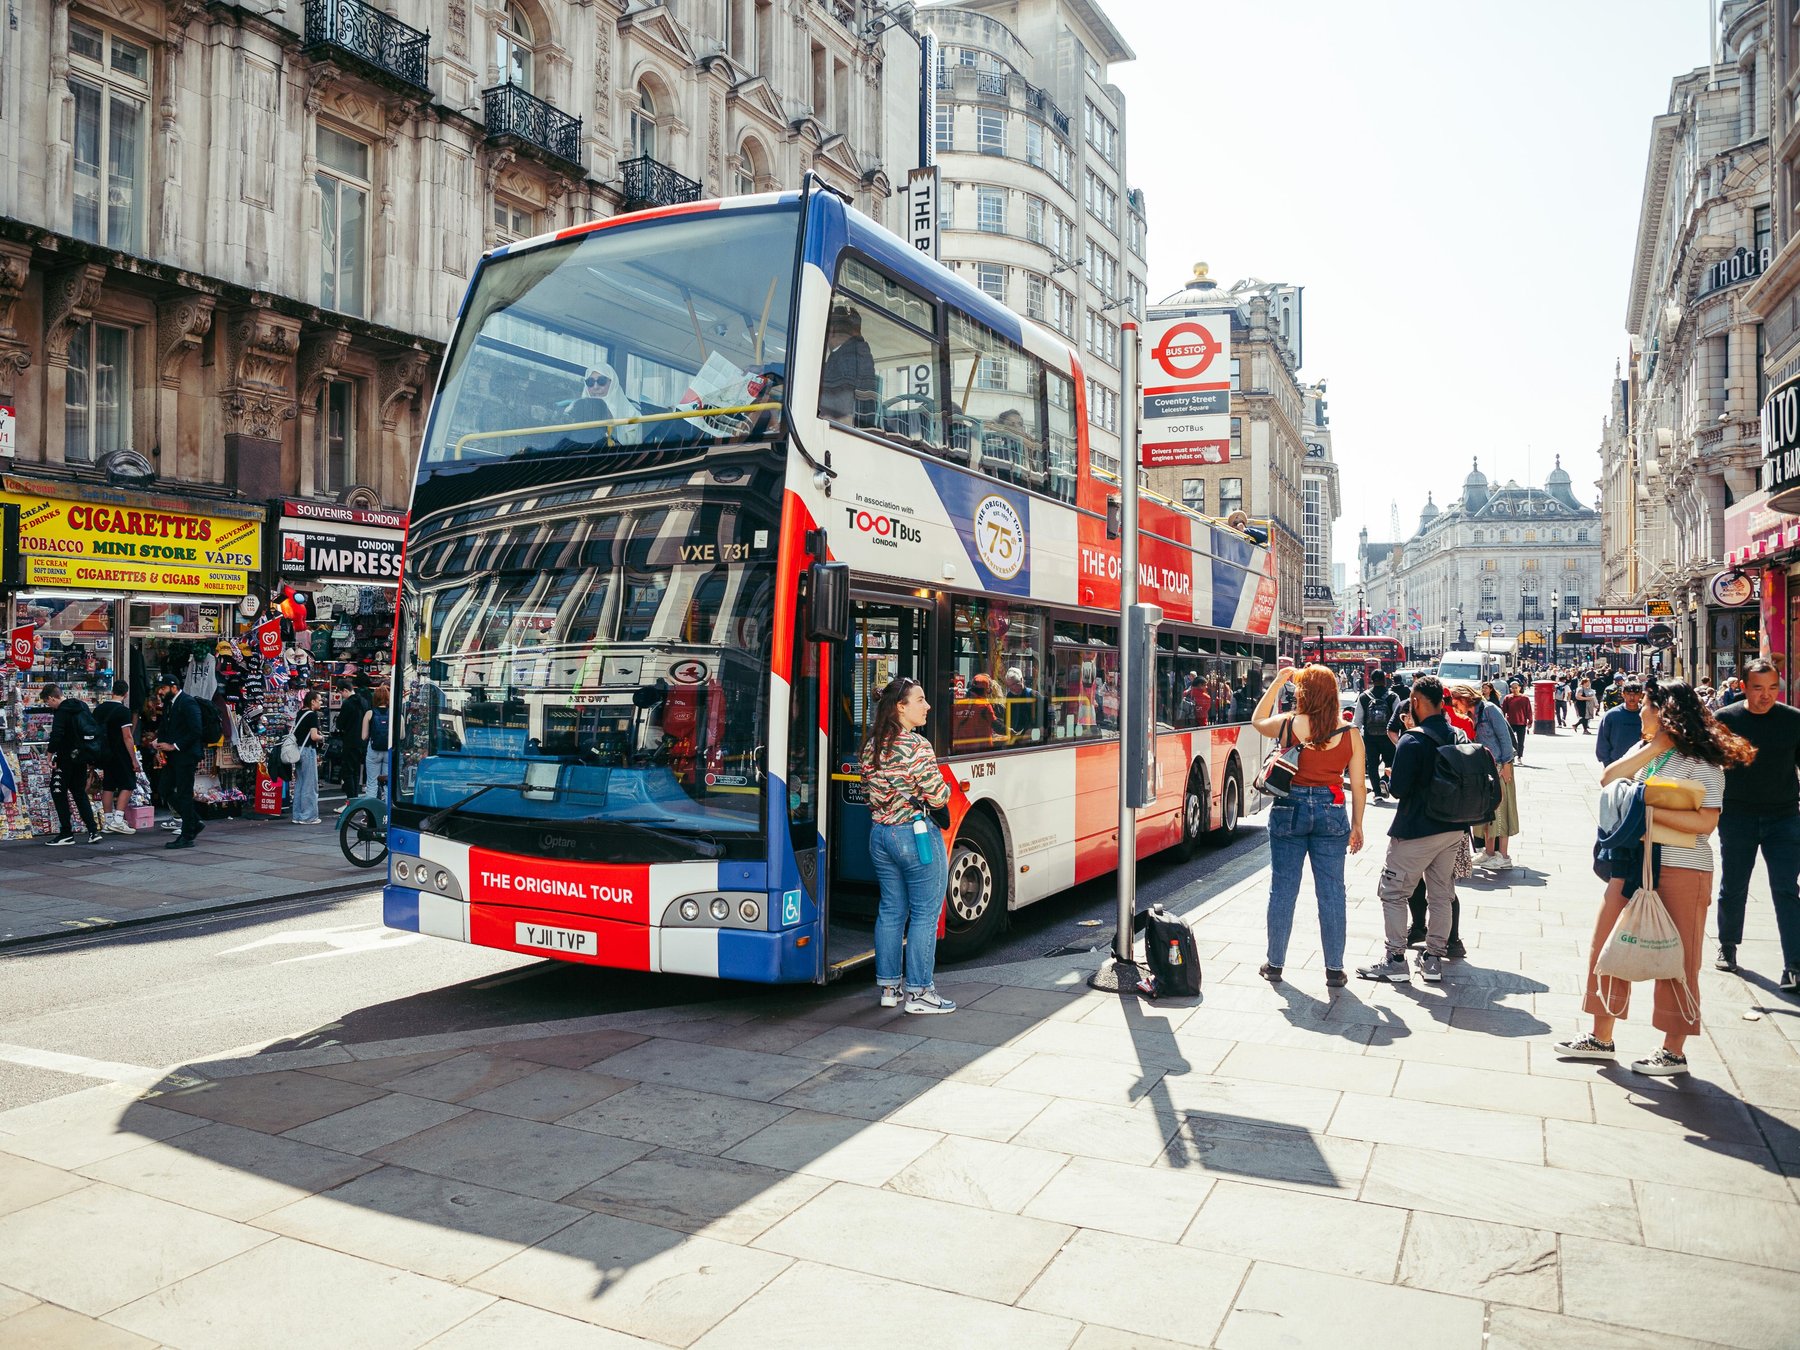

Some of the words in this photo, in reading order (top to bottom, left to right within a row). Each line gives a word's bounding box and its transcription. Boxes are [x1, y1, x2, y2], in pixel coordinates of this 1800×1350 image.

[915, 186, 930, 231] THE
[915, 237, 930, 256] B
[1166, 347, 1182, 356] BUS
[1184, 345, 1207, 355] STOP
[1155, 397, 1190, 408] Coventry
[1192, 395, 1216, 403] Street
[1162, 406, 1188, 414] Leicester
[1189, 404, 1209, 413] Square
[1776, 456, 1782, 483] &
[1784, 447, 1800, 481] BAR
[24, 480, 56, 494] Cream
[20, 502, 50, 520] CREAM
[855, 493, 863, 501] In
[864, 496, 900, 512] association
[901, 506, 914, 515] with
[29, 508, 60, 528] DRINKS
[68, 506, 212, 542] CIGARETTES
[297, 504, 353, 520] SOUVENIRS
[362, 512, 400, 526] LONDON
[978, 508, 986, 526] THE
[985, 500, 1013, 518] ORIGINAL
[1012, 518, 1022, 543] TOUR
[215, 522, 254, 544] SOUVENIRS
[218, 528, 256, 552] CONFECTIONERY
[872, 536, 898, 548] LONDON
[20, 537, 84, 553] TOBACCO
[93, 541, 136, 556] MINI
[140, 544, 197, 560] STORE
[358, 540, 394, 552] LONDON
[680, 545, 714, 562] VXE
[723, 543, 750, 560] 731
[46, 560, 68, 568] CREAM
[205, 551, 252, 566] VAPES
[310, 547, 402, 577] IMPRESS
[982, 552, 1017, 574] ANNIVERSARY
[48, 568, 66, 576] DRINKS
[76, 568, 146, 583] CIGARETTES
[150, 572, 159, 584] &
[162, 574, 200, 586] CIGARS
[210, 572, 241, 582] SOUVENIRS
[282, 564, 305, 572] LUGGAGE
[1082, 550, 1105, 577] THE
[1162, 568, 1190, 596] TOUR
[34, 576, 72, 584] CONFECTIONERY
[204, 582, 224, 590] MOBILE
[226, 583, 245, 592] TOP-UP
[971, 764, 984, 778] VXE
[986, 762, 996, 776] 731
[544, 834, 577, 849] Optare
[481, 872, 510, 889] THE
[514, 876, 587, 899] ORIGINAL
[590, 884, 633, 904] TOUR
[557, 932, 586, 950] TVP
